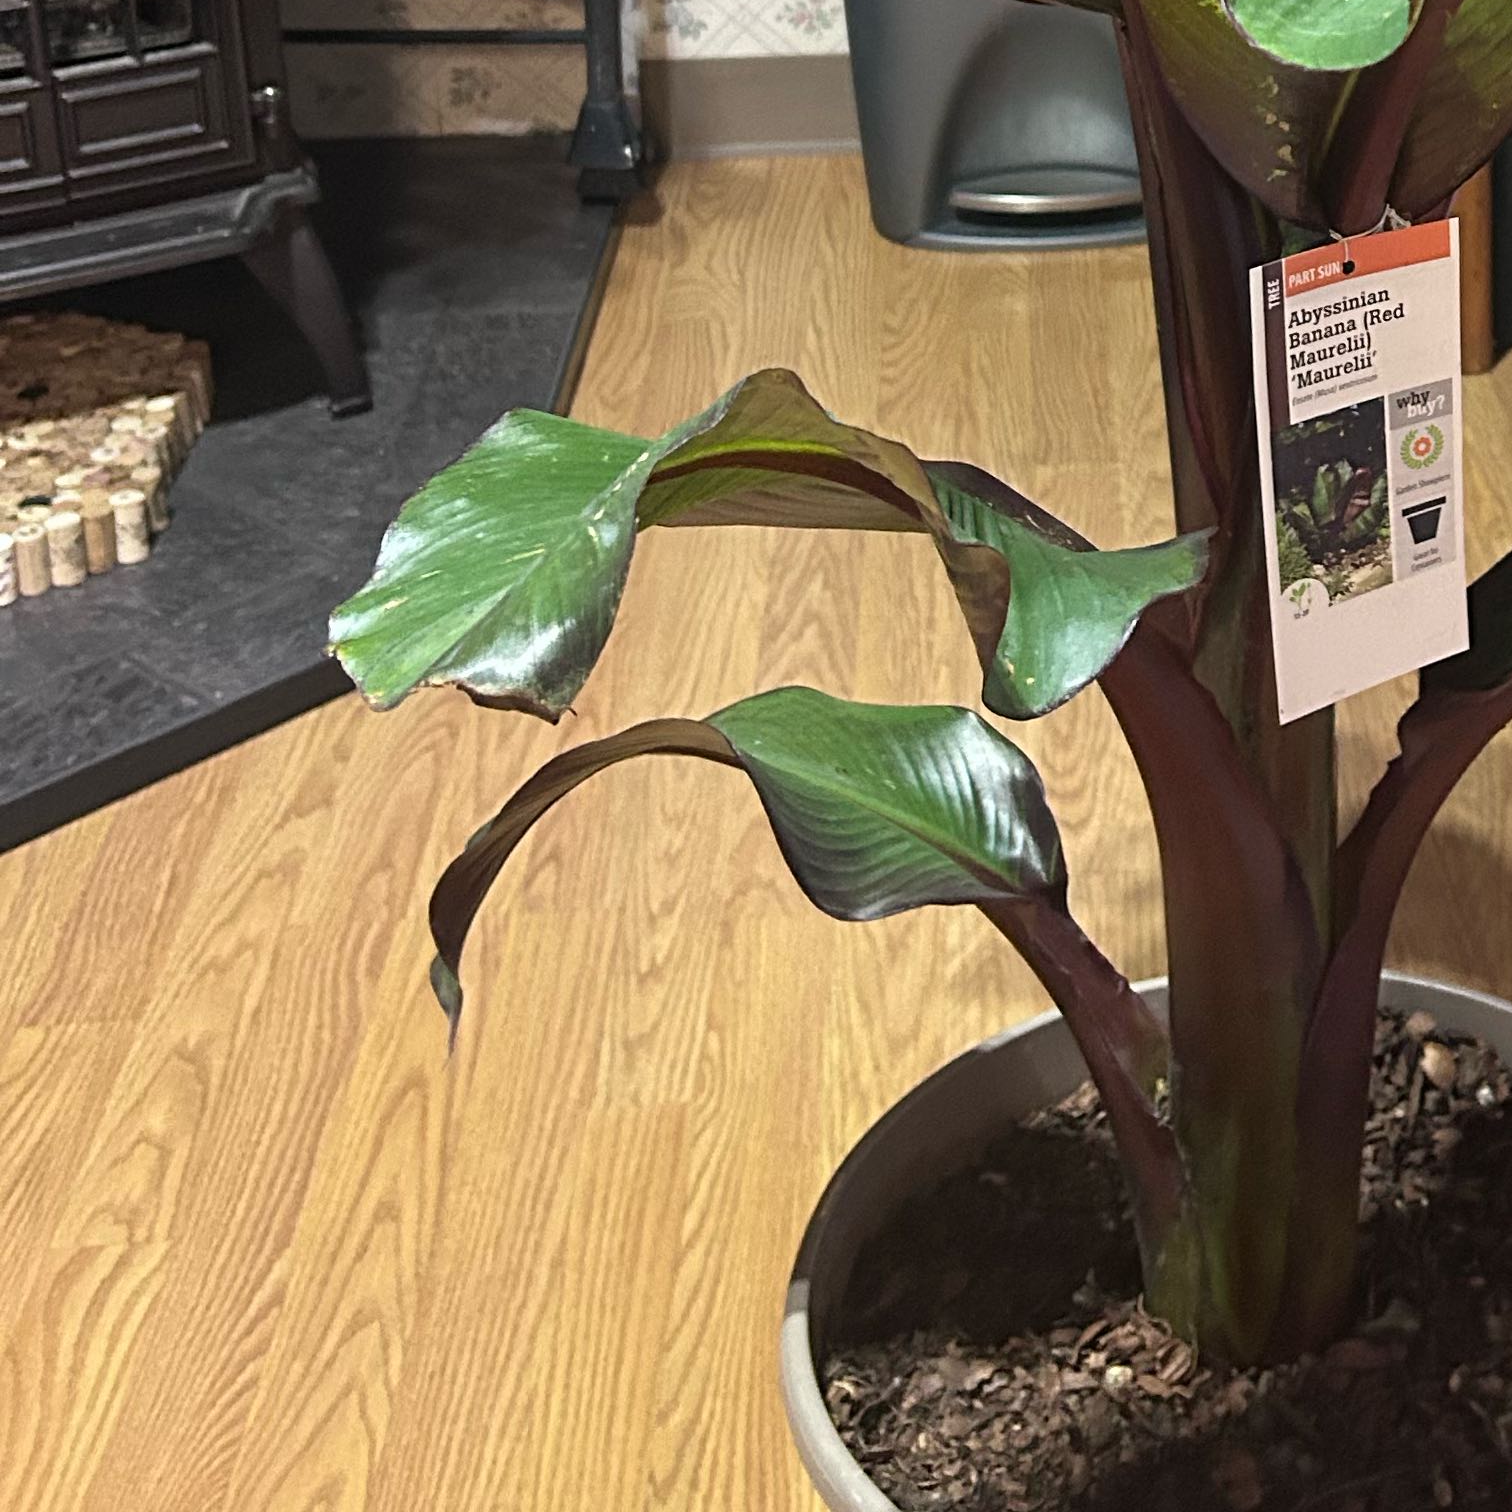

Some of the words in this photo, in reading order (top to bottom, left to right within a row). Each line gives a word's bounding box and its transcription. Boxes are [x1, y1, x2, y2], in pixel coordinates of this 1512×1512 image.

[1288, 268, 1316, 288] PART
[1318, 261, 1341, 280] SUN
[1267, 278, 1280, 310] TREE
[1288, 289, 1390, 329] Abyssinian
[1289, 318, 1357, 349] Banana
[1363, 303, 1405, 331] (Red
[1290, 331, 1371, 370] Maurelii)
[1396, 390, 1431, 410] why
[1407, 394, 1445, 418] buy?
